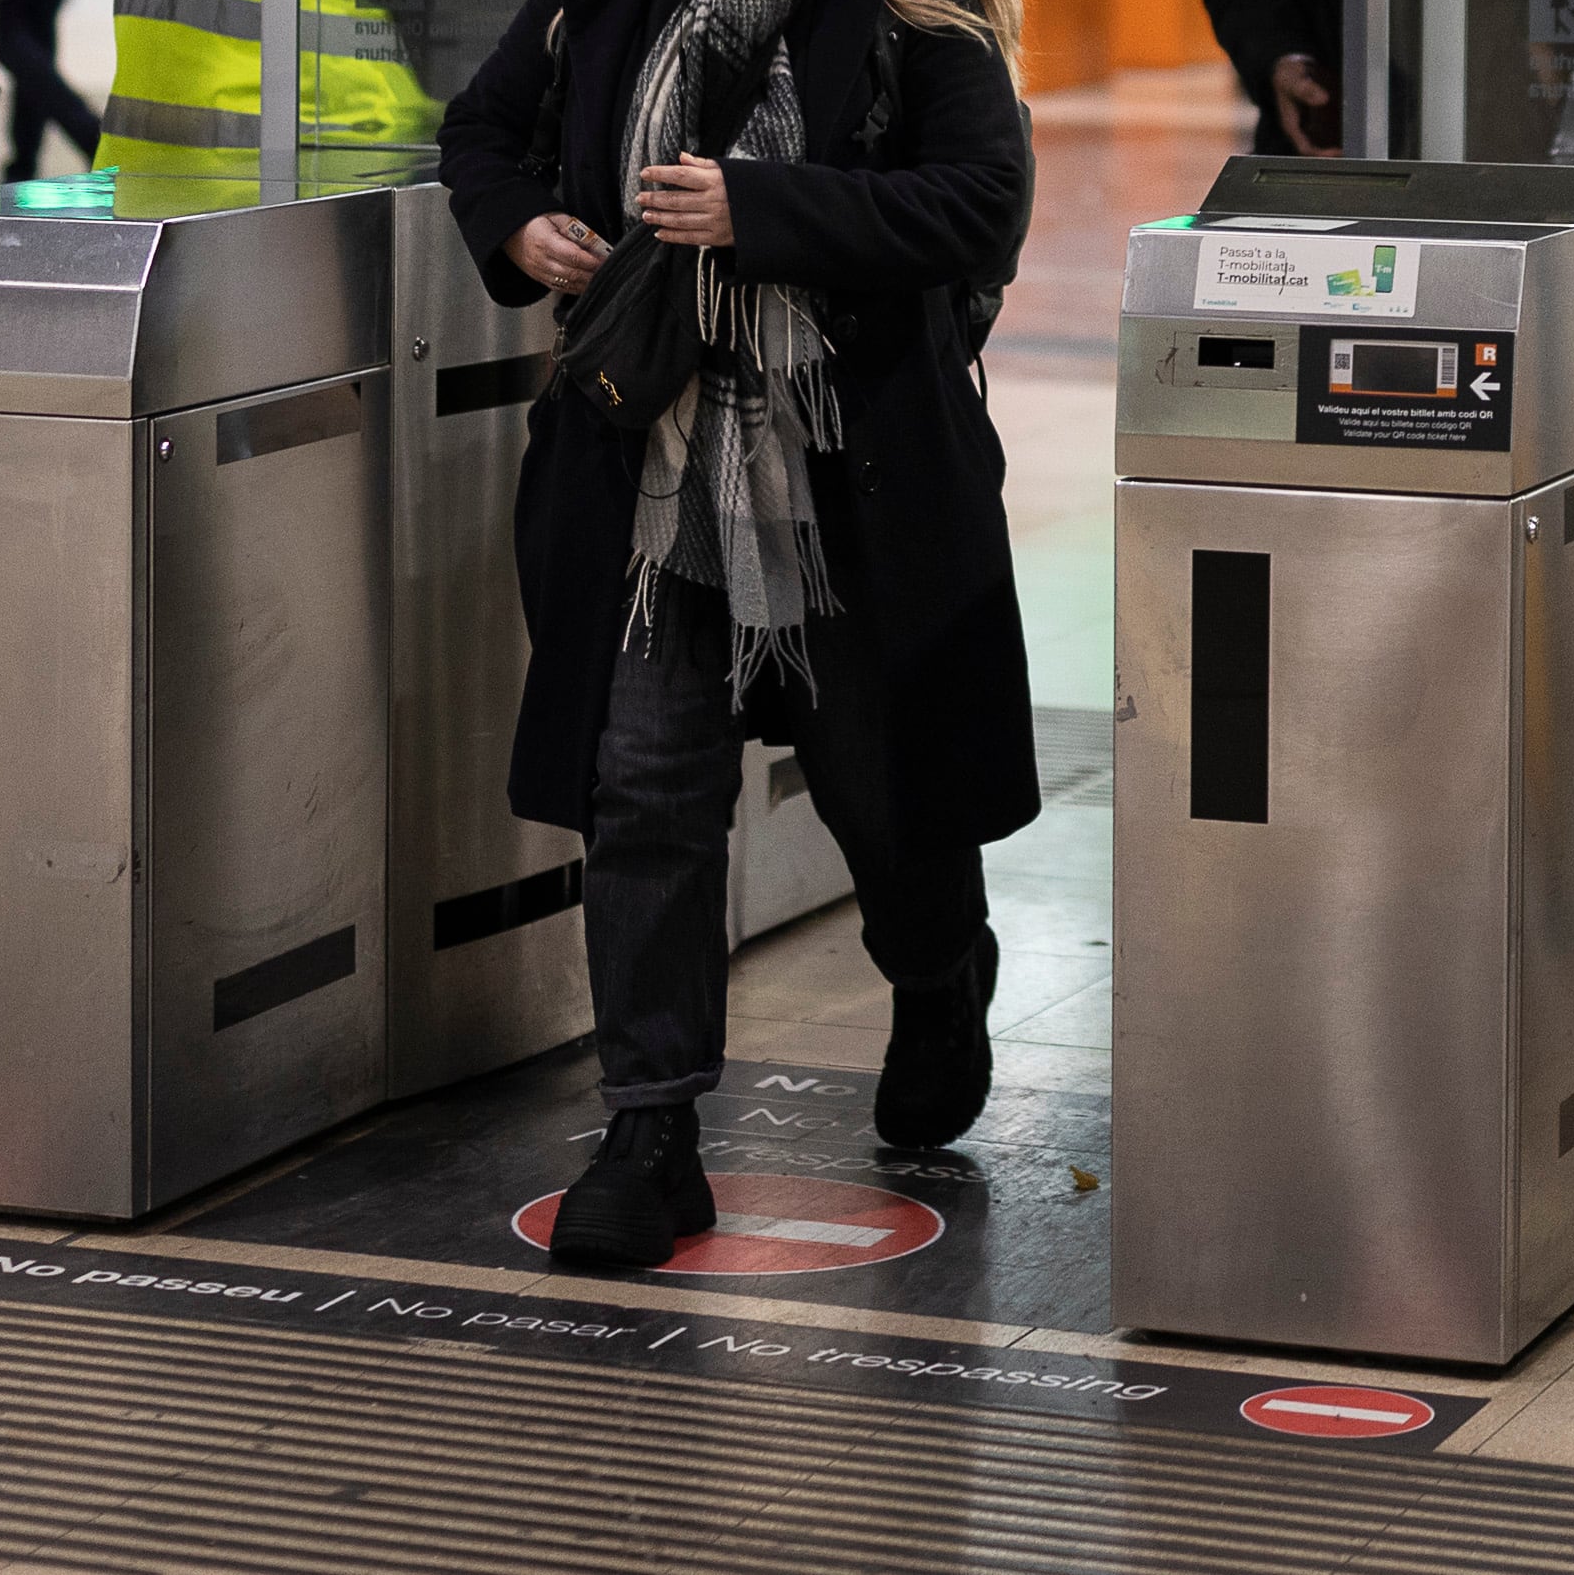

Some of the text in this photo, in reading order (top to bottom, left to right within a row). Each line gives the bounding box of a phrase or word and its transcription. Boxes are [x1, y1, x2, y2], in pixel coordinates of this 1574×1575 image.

[1220, 246, 1287, 259] Passa't a la
[1218, 259, 1285, 272] T-mobilitat
[1216, 272, 1309, 287] T-mobilitat.cat
[1483, 346, 1497, 361] R
[1318, 404, 1494, 420] Valideu aquí el vostre bitllet amb codi QR
[1415, 421, 1430, 429] con
[1431, 421, 1458, 431] código
[1459, 421, 1472, 430] QR
[1343, 428, 1373, 438] Validate
[1373, 431, 1391, 440] your
[1392, 431, 1405, 440] QR
[1406, 432, 1425, 440] code
[753, 1074, 858, 1096] No
[738, 1107, 840, 1130] No
[697, 1139, 988, 1183] trespass
[71, 1267, 305, 1305] passeu
[365, 1296, 453, 1319] No
[460, 1307, 640, 1342] pasar
[697, 1334, 792, 1357] No
[807, 1346, 1169, 1401] trespassing
